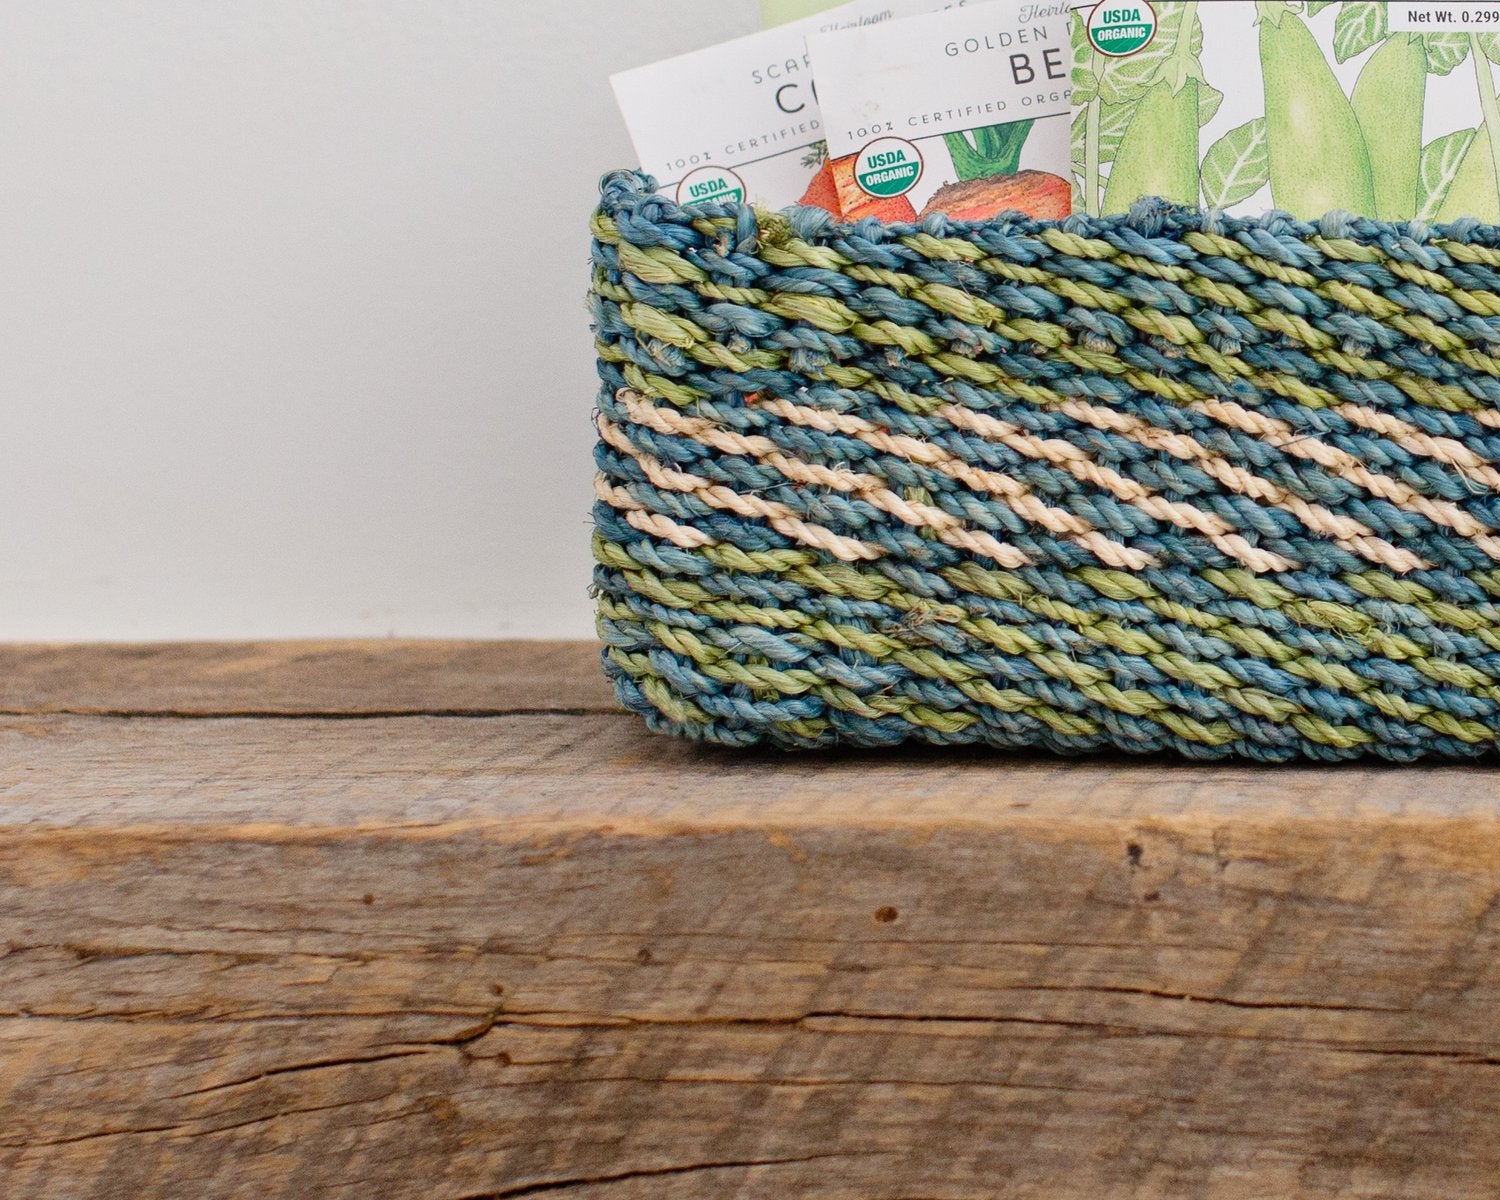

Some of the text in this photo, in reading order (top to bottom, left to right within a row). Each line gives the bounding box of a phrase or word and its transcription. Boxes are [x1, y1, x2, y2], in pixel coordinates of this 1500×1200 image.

[1102, 9, 1141, 25] USDA
[1408, 10, 1434, 23] Net
[1437, 10, 1457, 23] Wt.
[1461, 10, 1500, 23] 0.299
[945, 25, 1048, 57] GOLDEN
[1097, 25, 1147, 42] ORGANIC
[1009, 47, 1066, 85] BE
[847, 121, 894, 140] 100%
[908, 100, 1007, 127] CERTIFIED
[724, 119, 820, 154] CERTIFIED
[867, 149, 906, 169] USDA
[864, 167, 915, 186] ORGANIC
[689, 177, 728, 198] USDA
